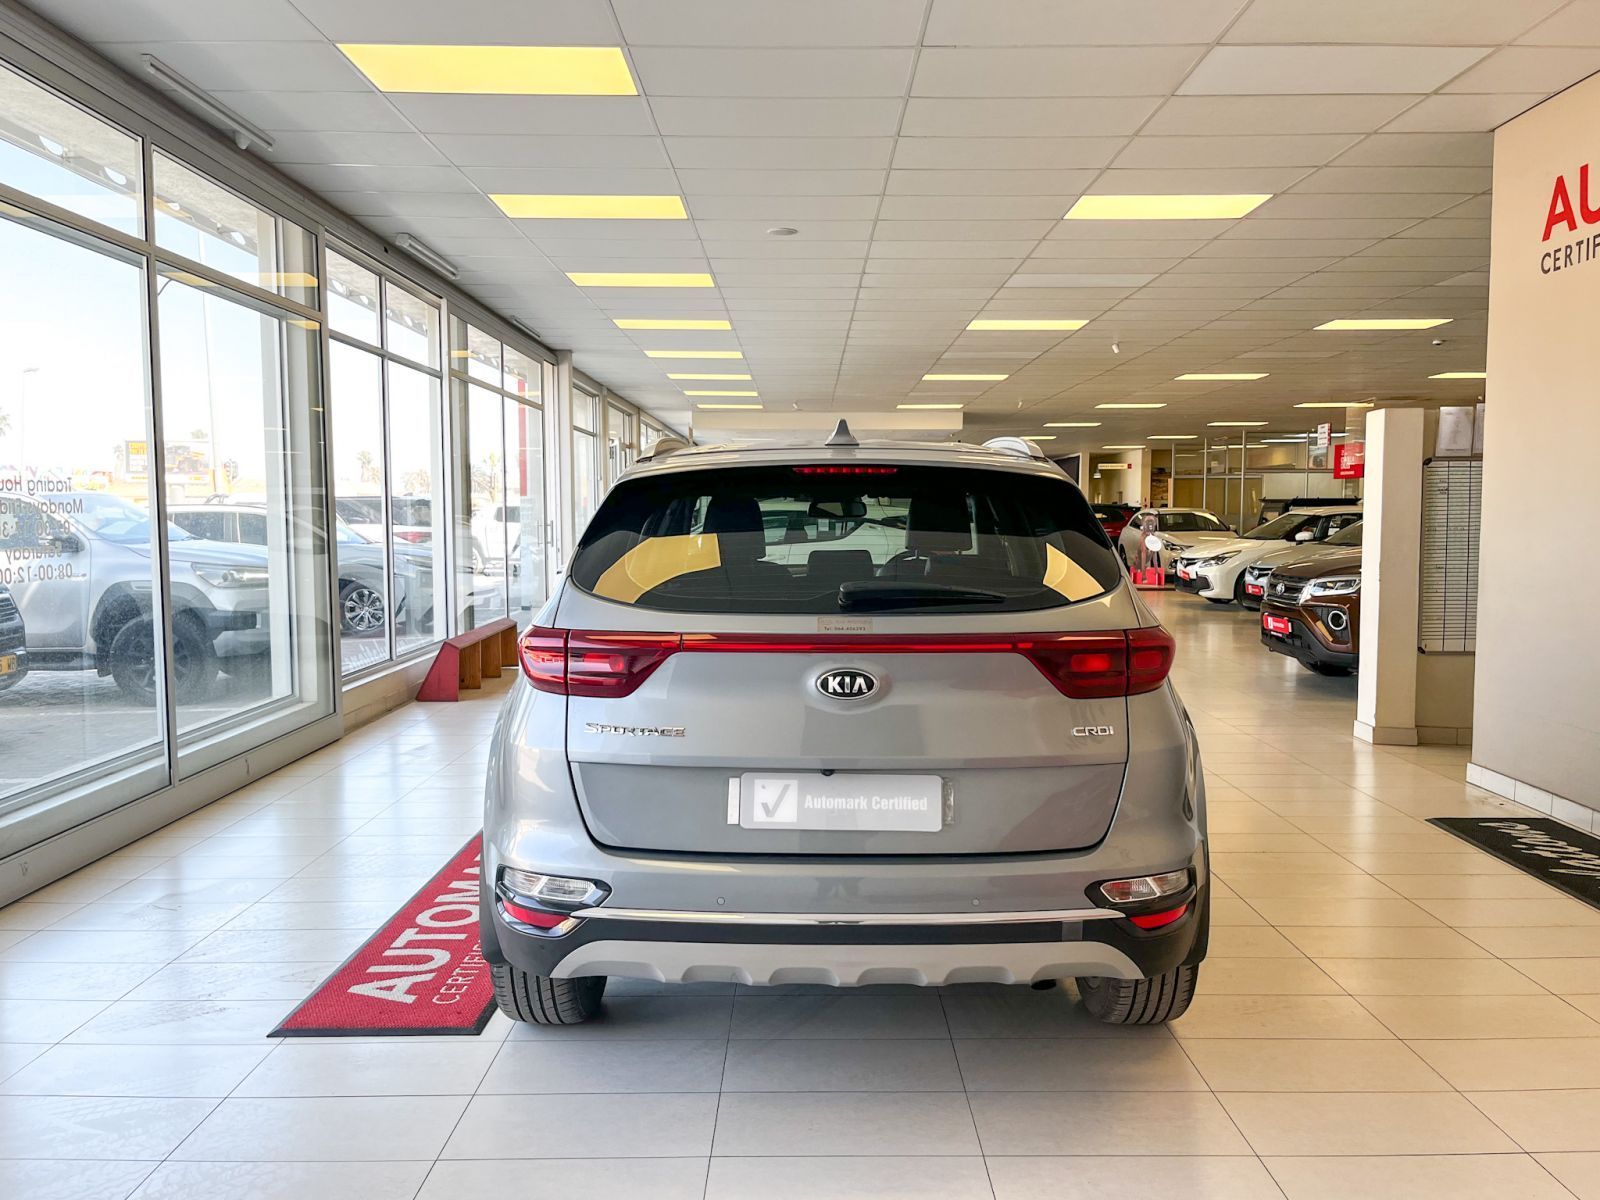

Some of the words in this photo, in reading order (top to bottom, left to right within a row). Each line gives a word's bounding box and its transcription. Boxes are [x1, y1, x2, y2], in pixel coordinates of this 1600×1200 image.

[827, 675, 869, 693] KIA
[583, 722, 686, 737] SPORTAGE
[804, 795, 867, 809] Automark
[871, 796, 928, 811] Certified
[347, 853, 481, 1004] AUTOM
